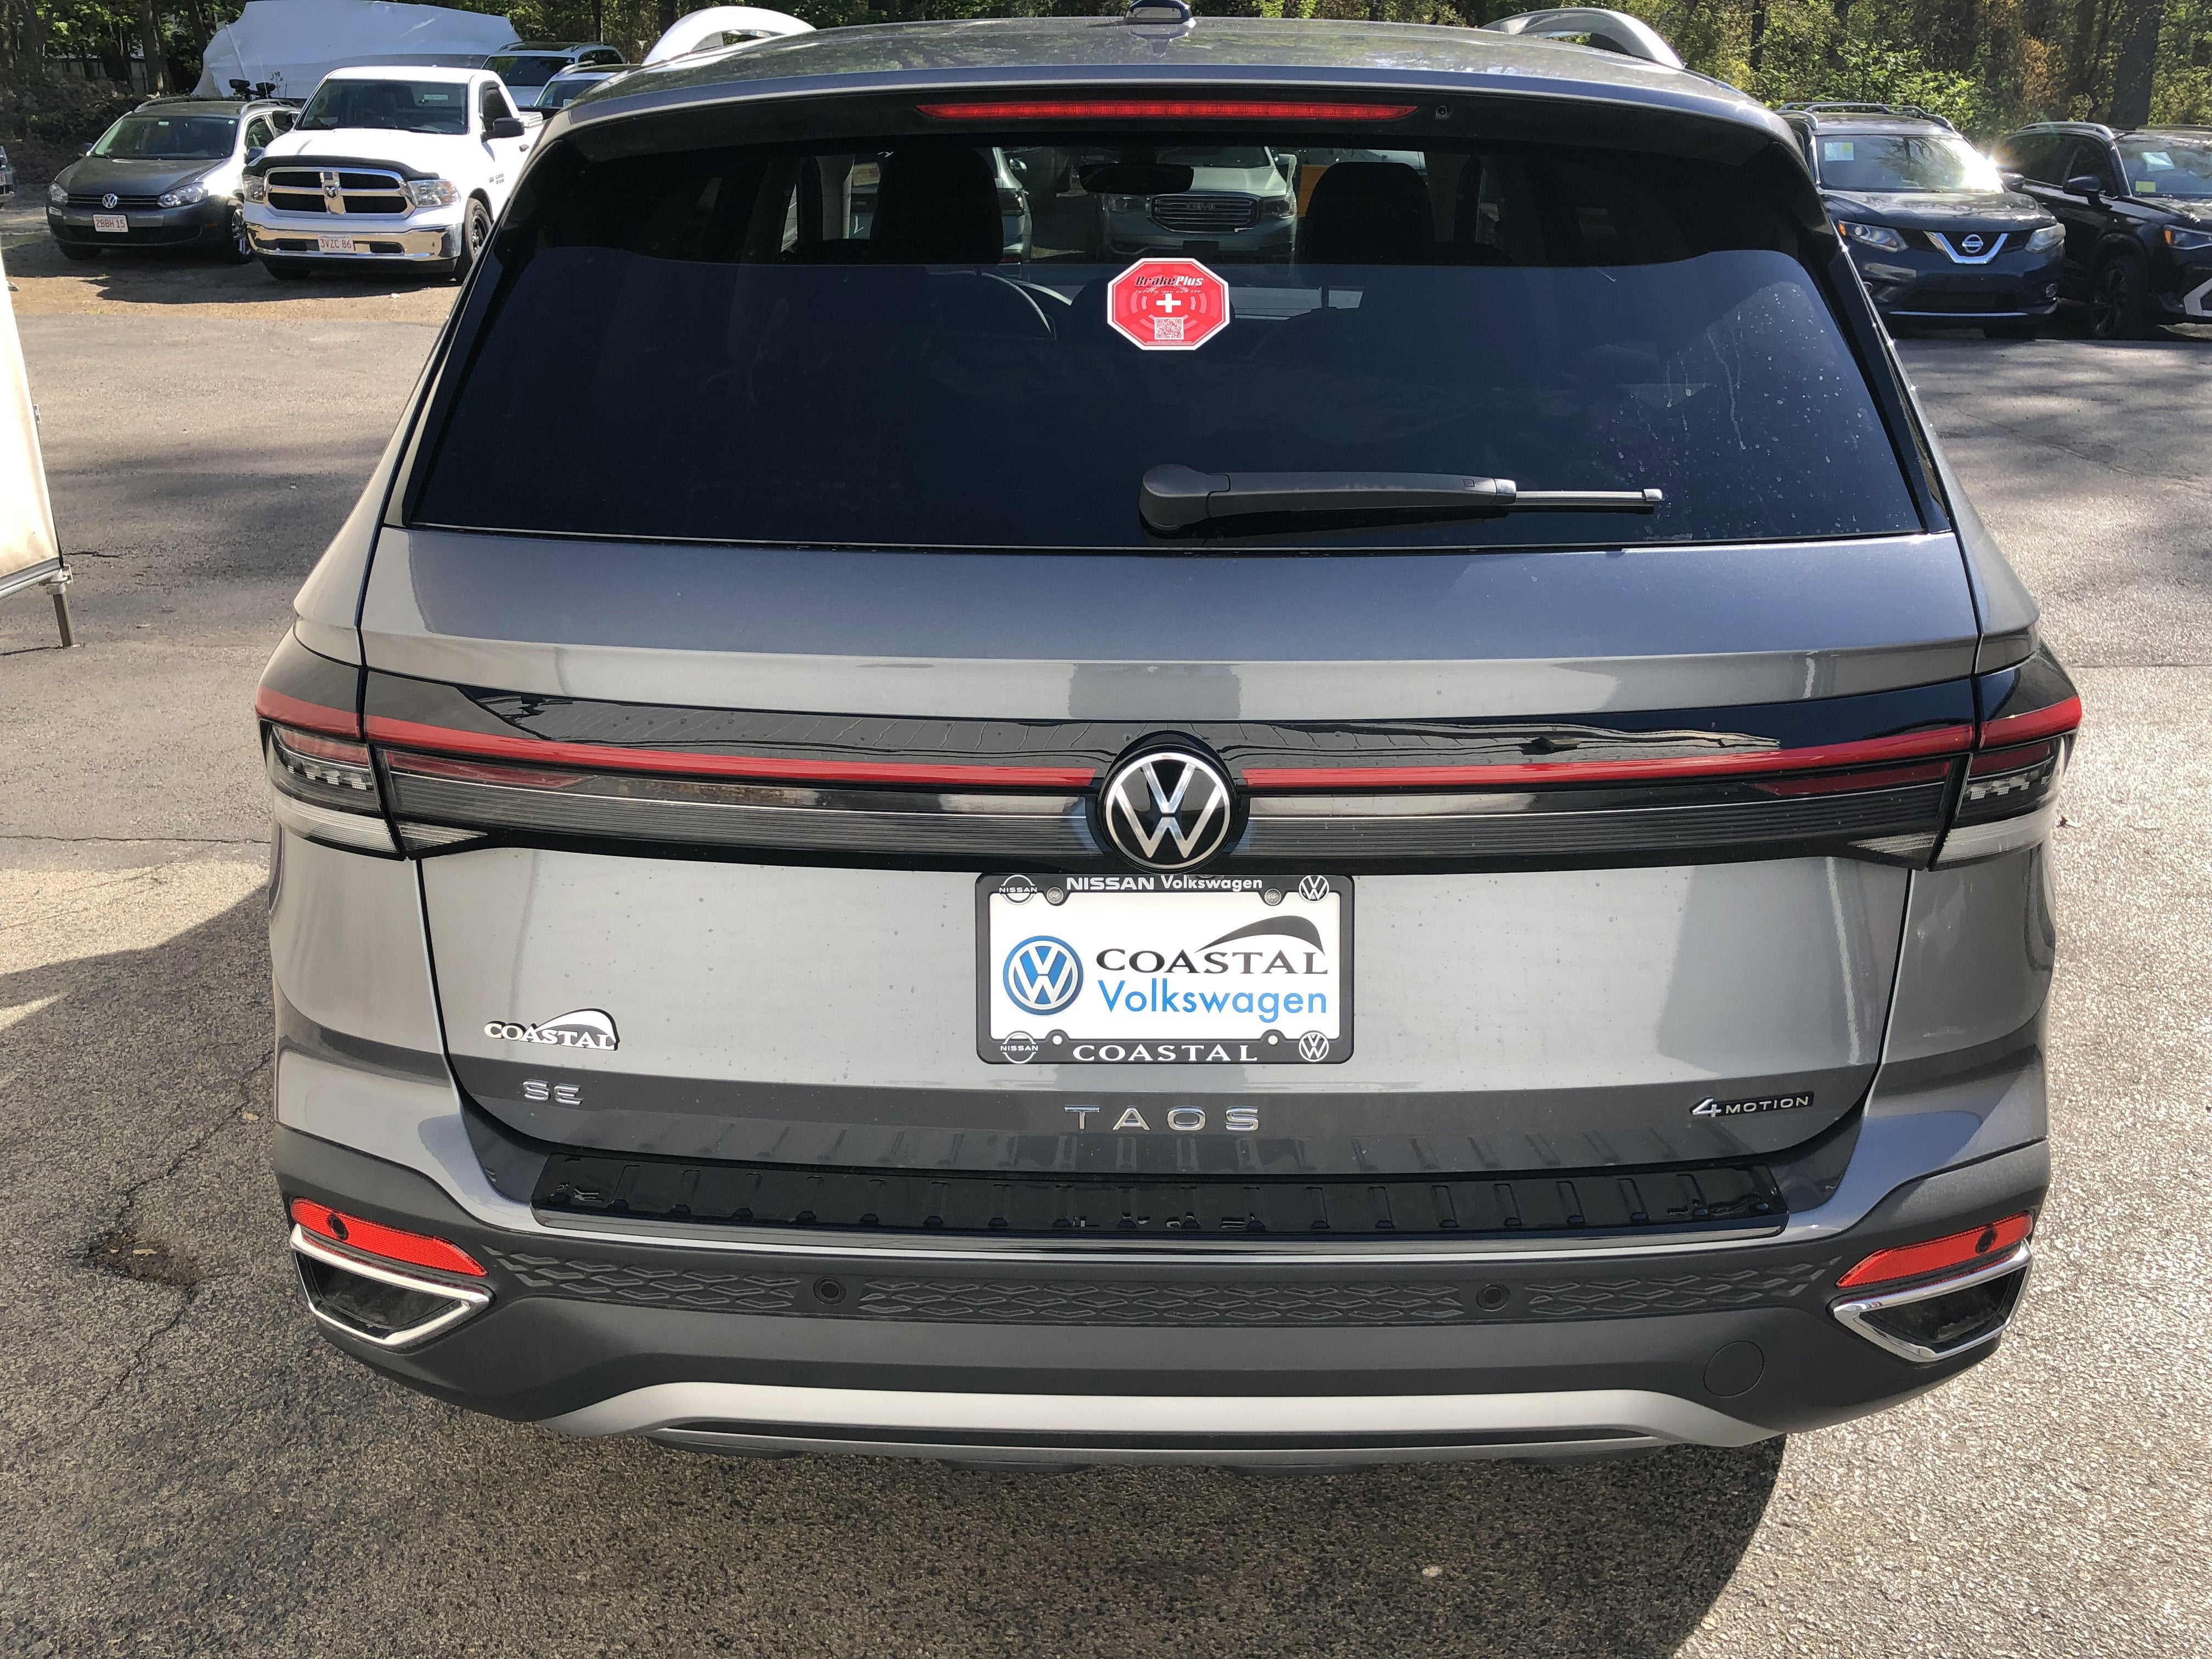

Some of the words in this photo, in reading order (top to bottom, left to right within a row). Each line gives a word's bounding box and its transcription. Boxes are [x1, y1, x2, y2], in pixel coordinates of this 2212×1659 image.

[116, 219, 125, 228] 15
[320, 239, 339, 249] 3VZC
[342, 239, 352, 249] 86
[1136, 276, 1204, 286] BrakePlus
[1113, 760, 1224, 860] VW
[1066, 877, 1154, 890] NISSAN
[1160, 874, 1262, 892] Volkswagen
[1300, 875, 1328, 901] VW
[1096, 948, 1328, 975] COASTAL
[1009, 941, 1077, 1009] VW
[1097, 978, 1327, 1023] Volkswagen
[484, 1022, 616, 1051] COASTAL
[1300, 1032, 1328, 1061] VW
[1073, 1044, 1258, 1062] COASTAL
[522, 1079, 584, 1105] SE
[1064, 1105, 1259, 1131] TAOS
